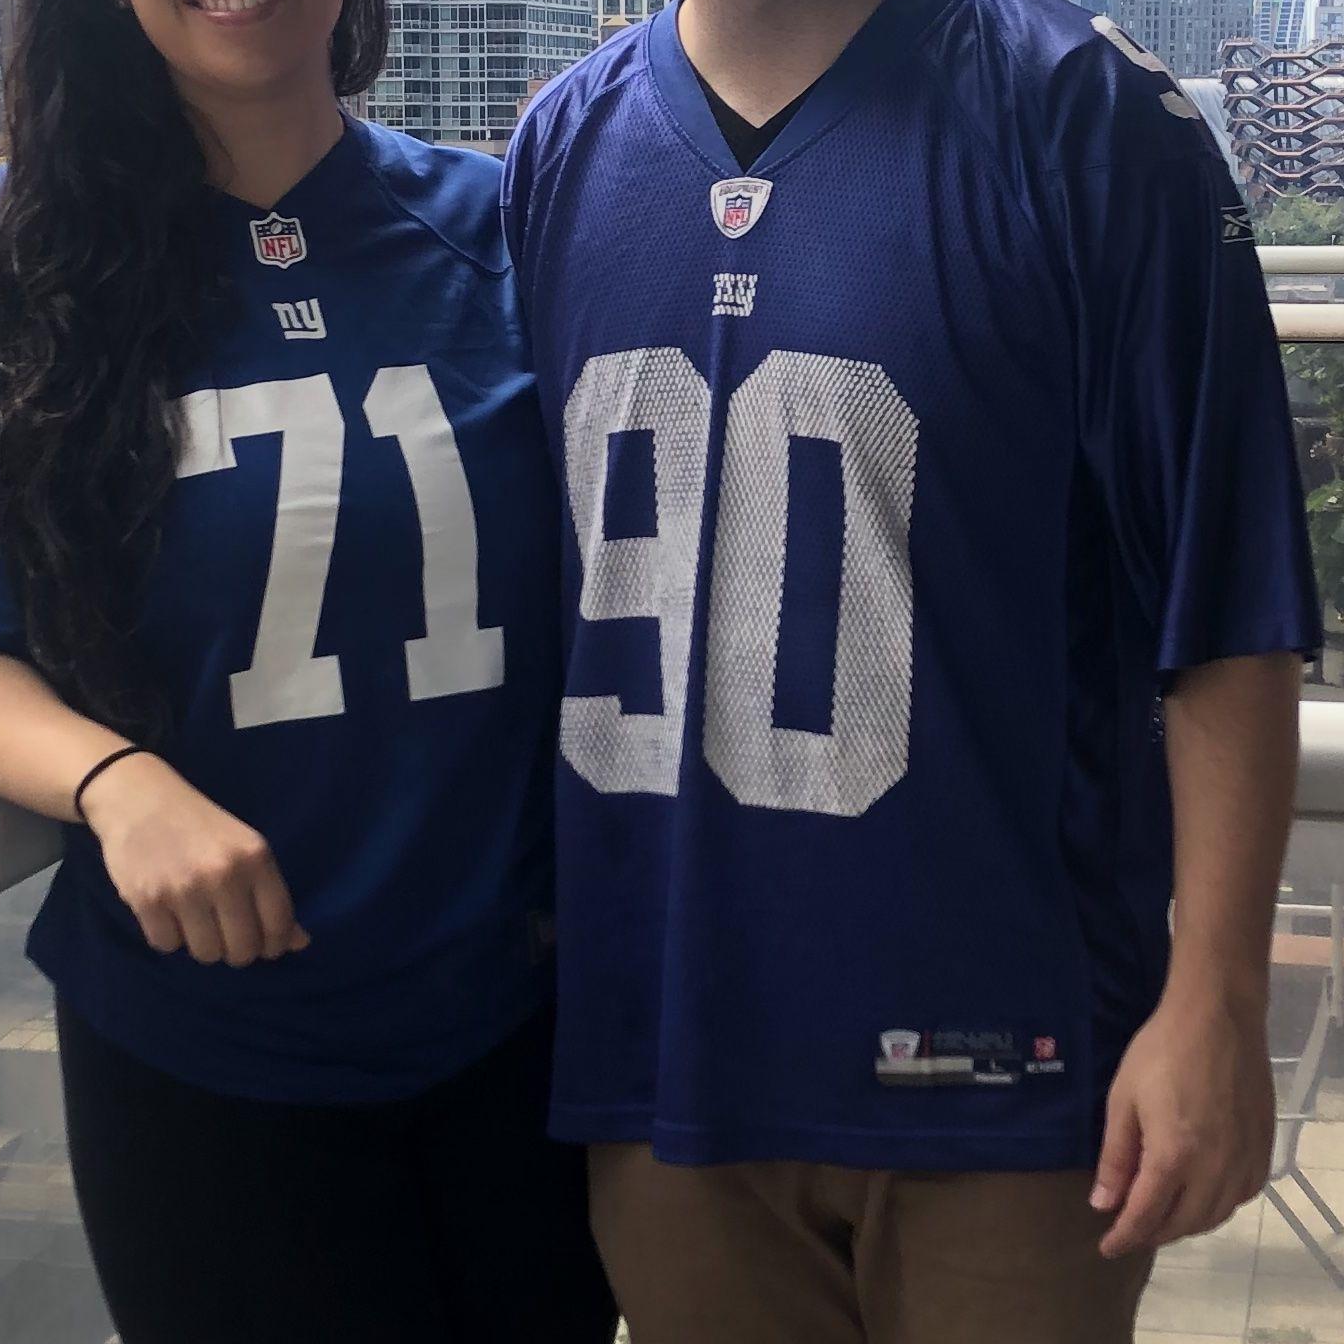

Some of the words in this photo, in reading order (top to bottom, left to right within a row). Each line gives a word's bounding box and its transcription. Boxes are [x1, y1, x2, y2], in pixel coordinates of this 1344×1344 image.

[262, 237, 301, 257] NFL
[170, 364, 506, 730] 71
[559, 346, 920, 818] 90
